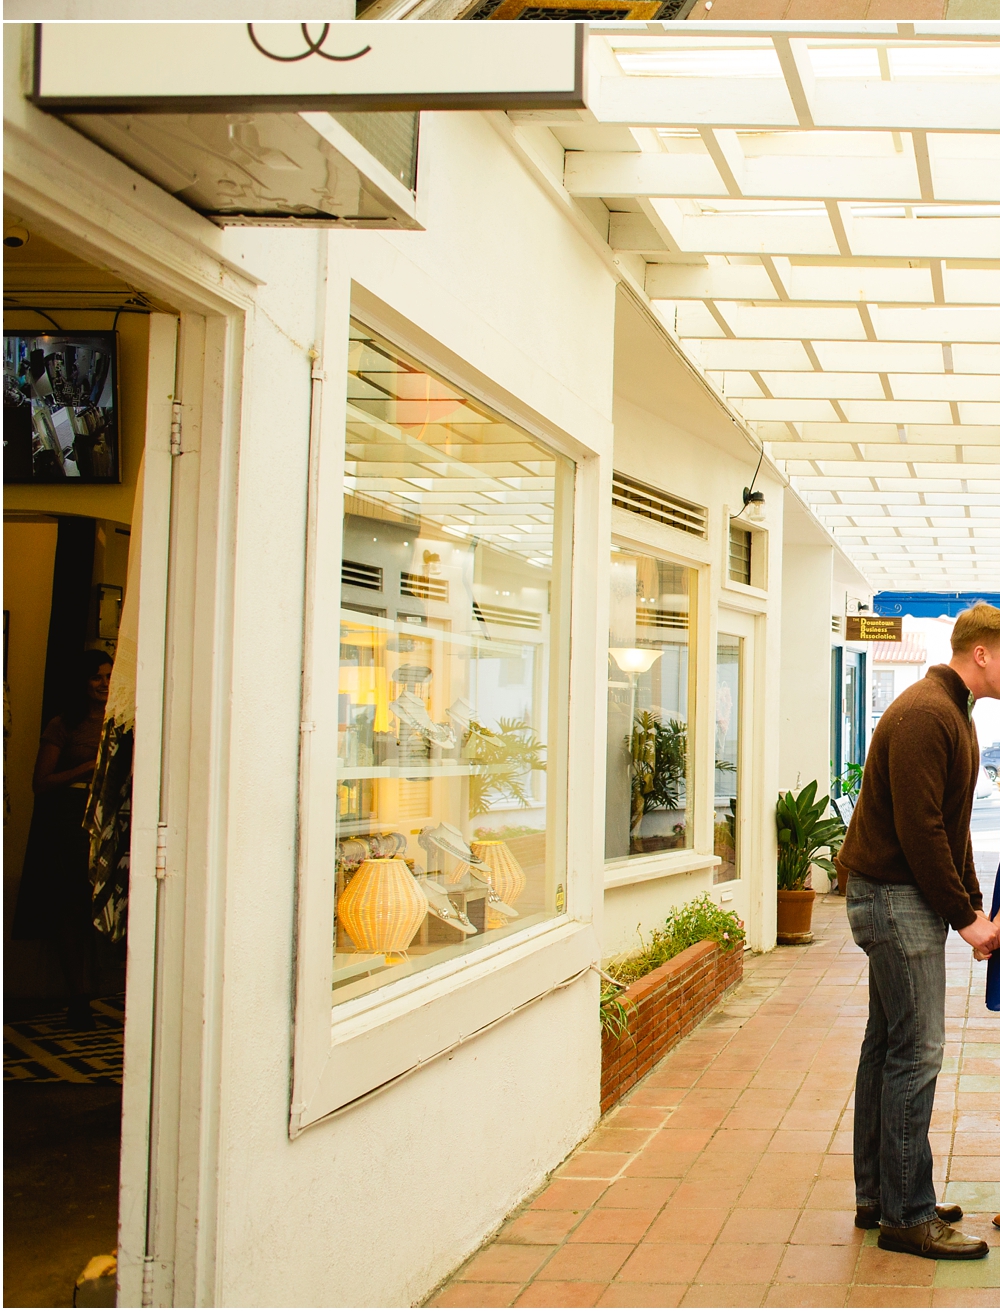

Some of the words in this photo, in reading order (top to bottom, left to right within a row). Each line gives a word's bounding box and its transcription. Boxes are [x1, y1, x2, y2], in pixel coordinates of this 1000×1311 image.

[860, 617, 895, 626] Downtown
[860, 624, 888, 633] Business
[860, 631, 897, 640] Association
